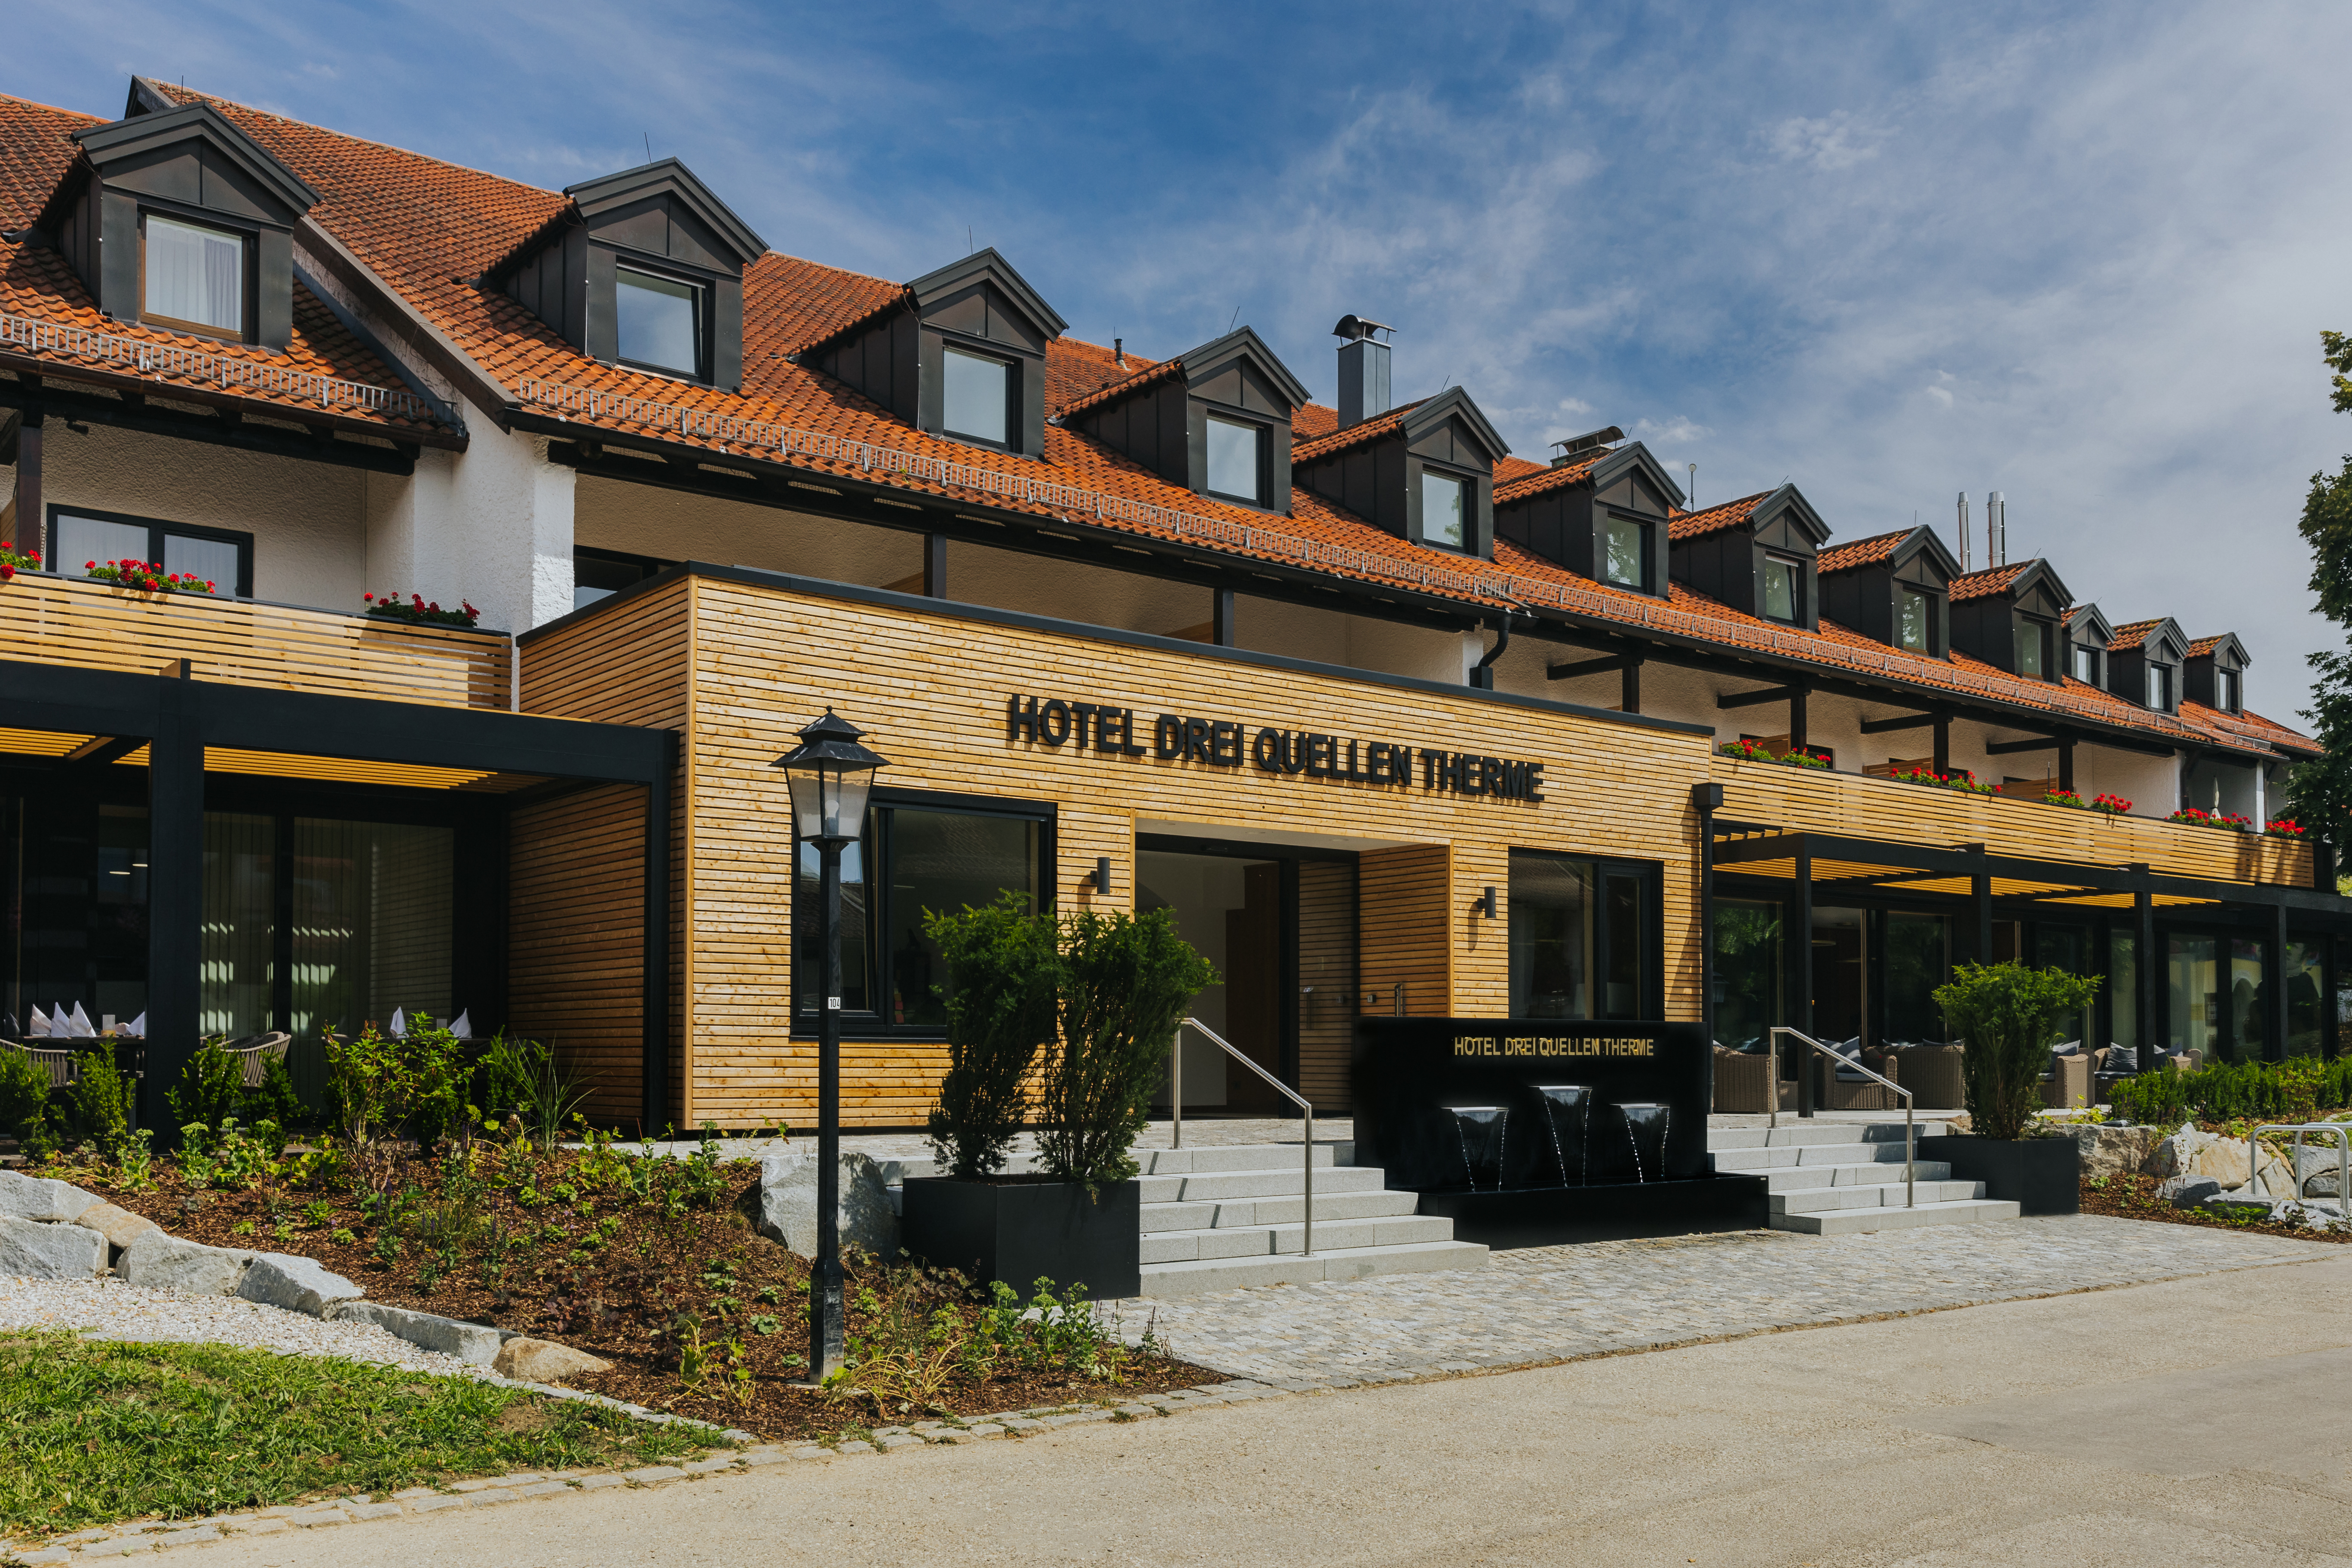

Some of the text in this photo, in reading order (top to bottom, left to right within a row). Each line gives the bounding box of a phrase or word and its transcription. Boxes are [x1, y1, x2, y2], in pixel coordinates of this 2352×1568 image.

[1011, 693, 1545, 801] HOTEL DREI QUELLEN THERME
[830, 998, 839, 1008] 104
[1455, 1037, 1654, 1057] HOTEL DREI QUELLEN THERME
